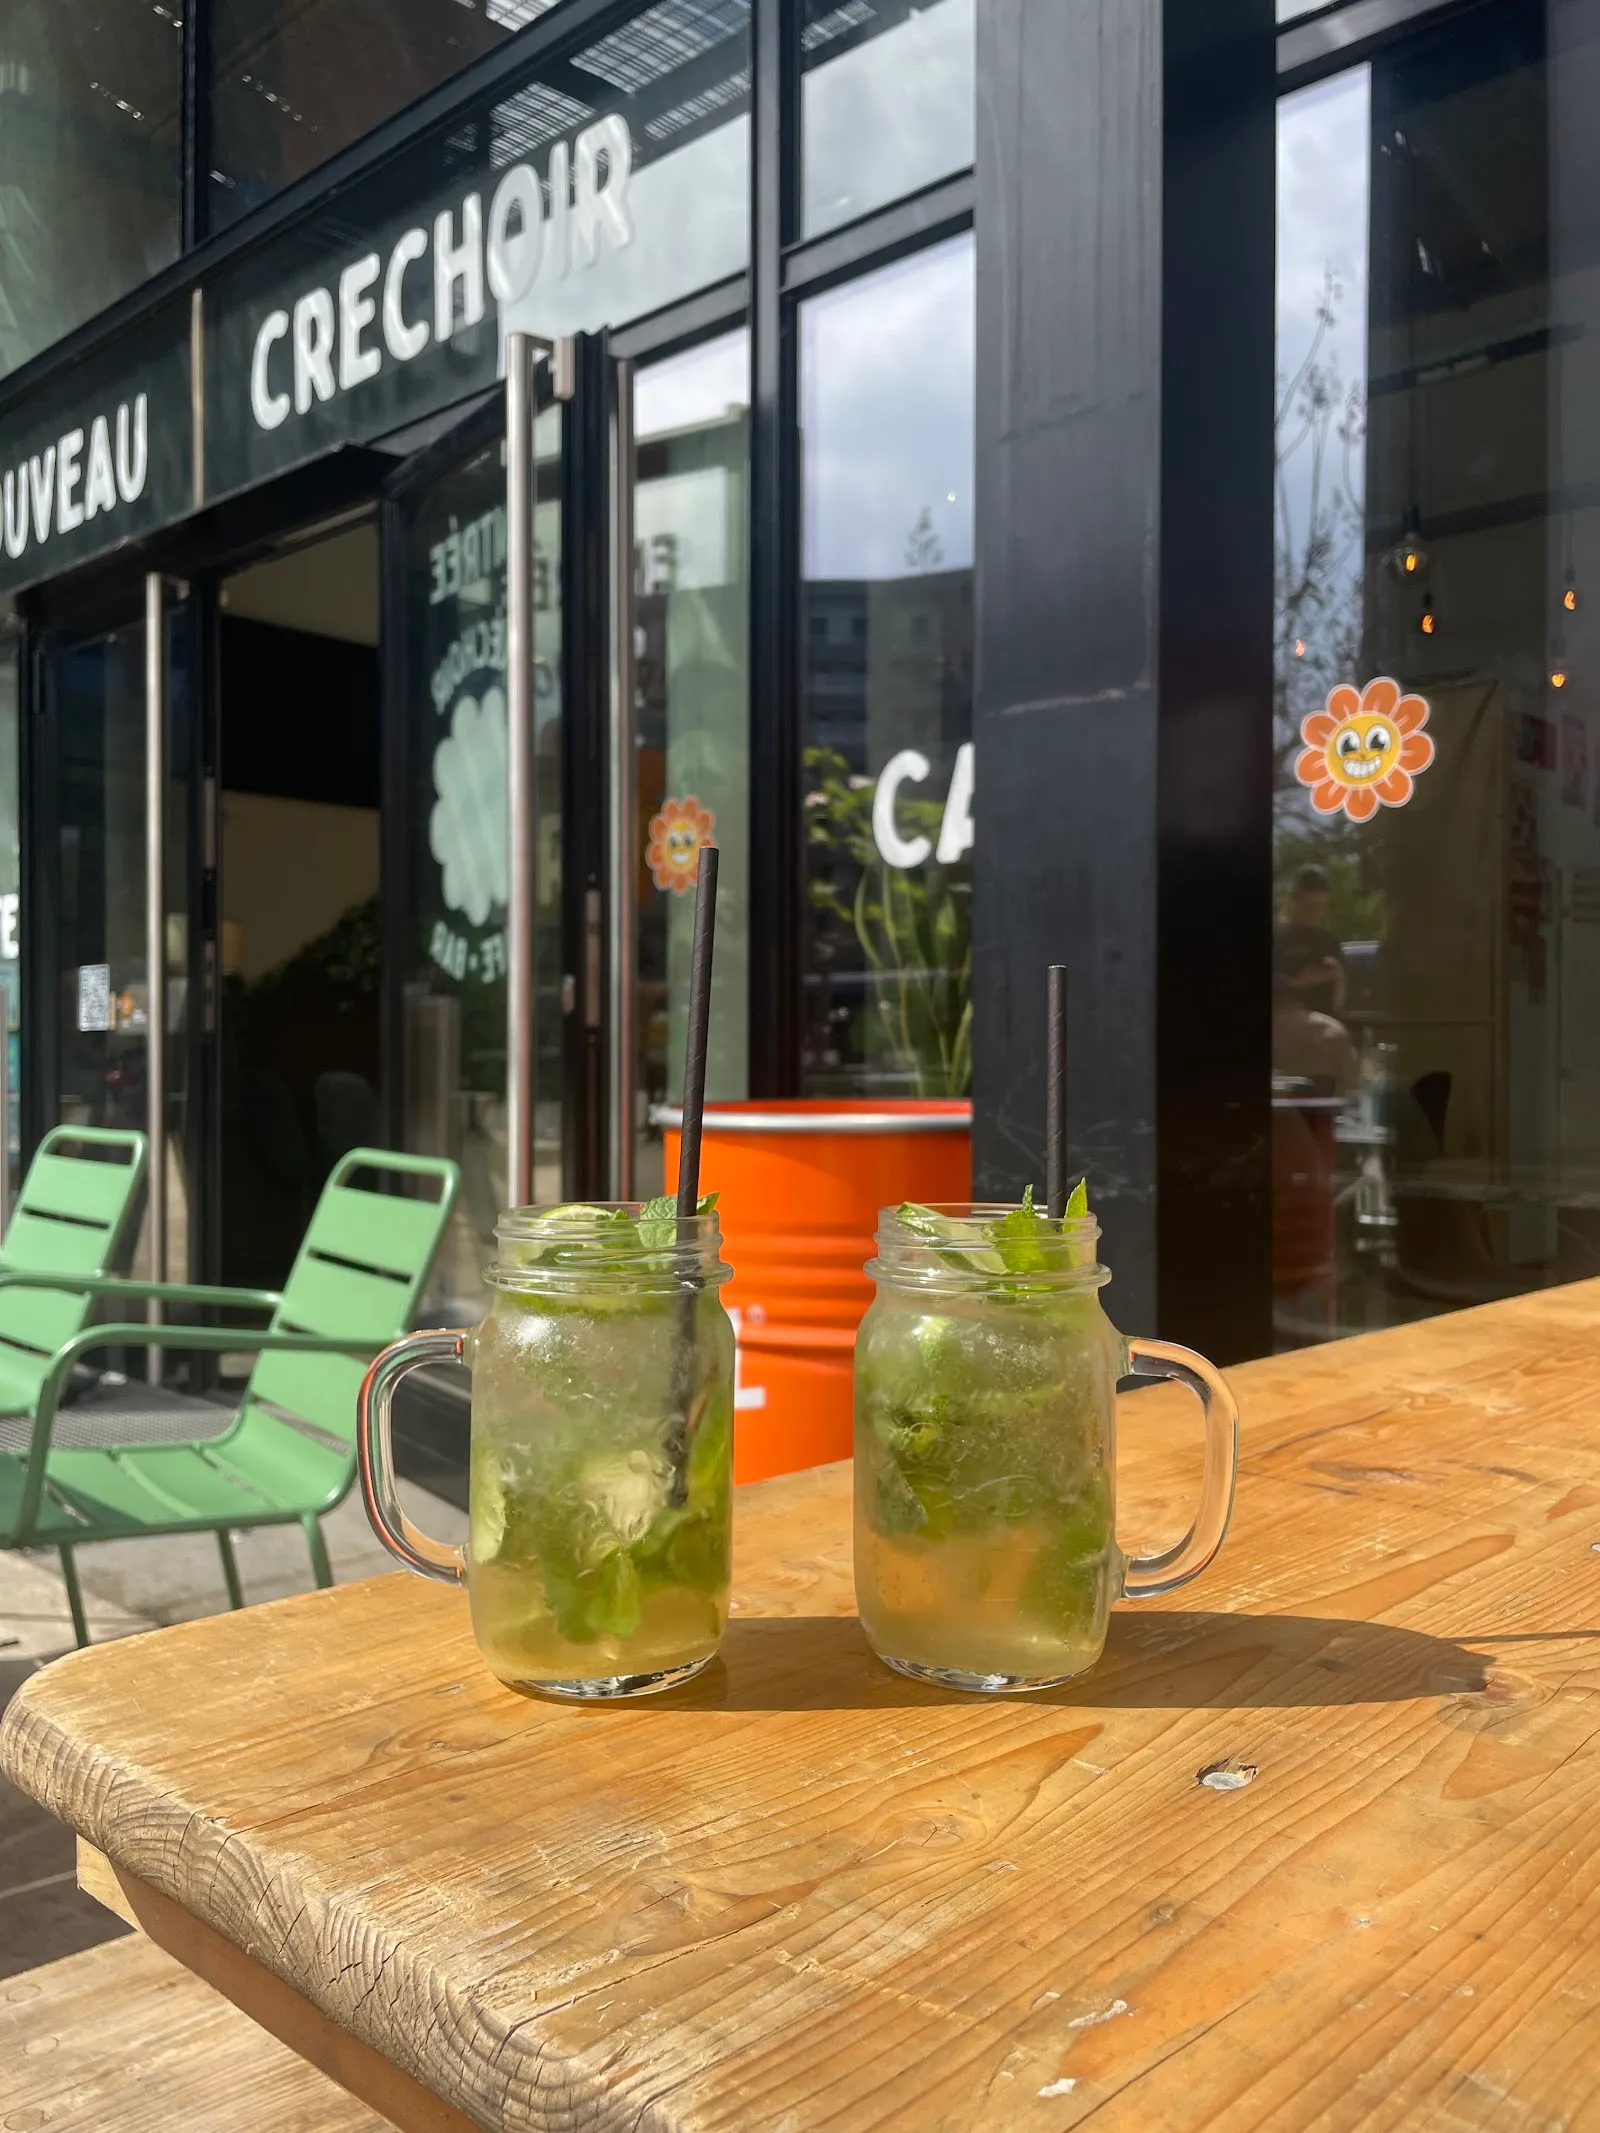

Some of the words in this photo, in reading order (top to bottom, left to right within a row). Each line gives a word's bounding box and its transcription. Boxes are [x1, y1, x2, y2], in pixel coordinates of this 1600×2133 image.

[0, 392, 148, 559] UVEAU
[250, 112, 633, 431] CRECHOIR
[0, 892, 19, 959] E
